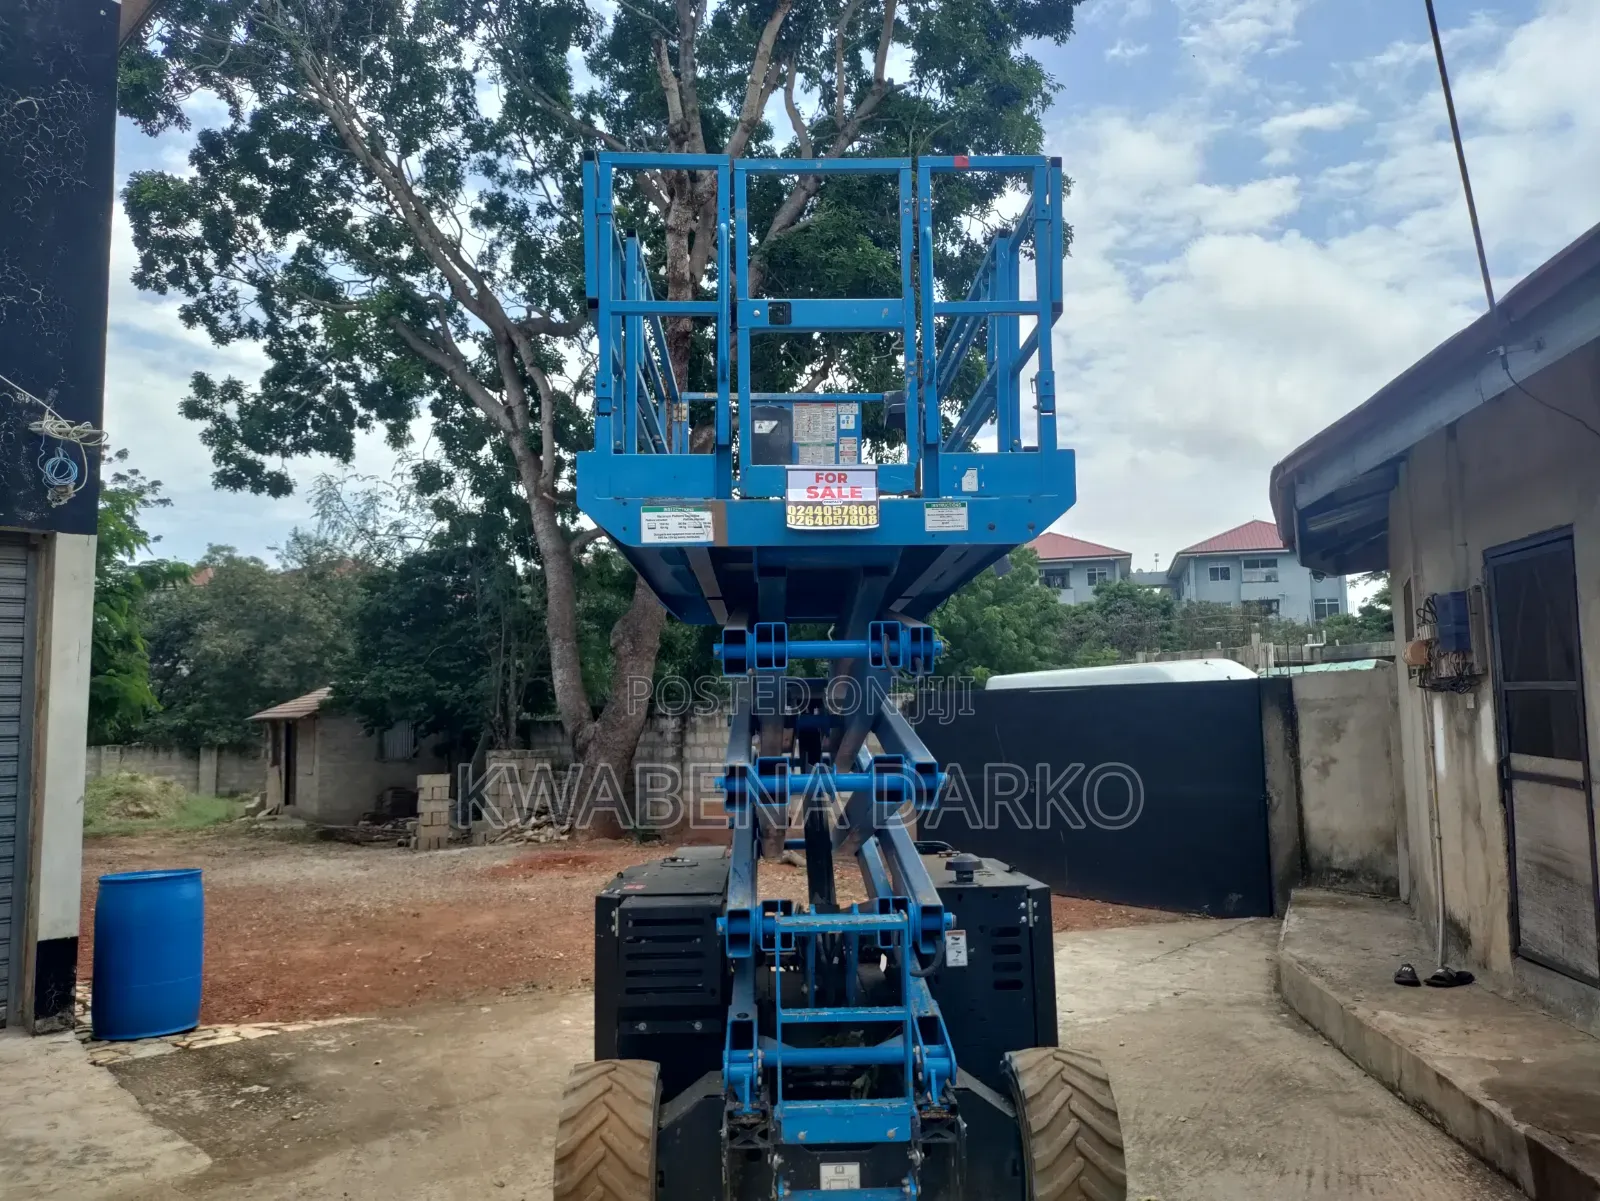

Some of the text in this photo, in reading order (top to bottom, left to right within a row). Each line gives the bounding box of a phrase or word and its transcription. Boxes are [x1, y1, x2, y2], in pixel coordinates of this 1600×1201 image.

[815, 472, 848, 483] FOR
[806, 485, 863, 499] SALE
[787, 505, 877, 516] 0244057808
[787, 515, 878, 526] 0264057808
